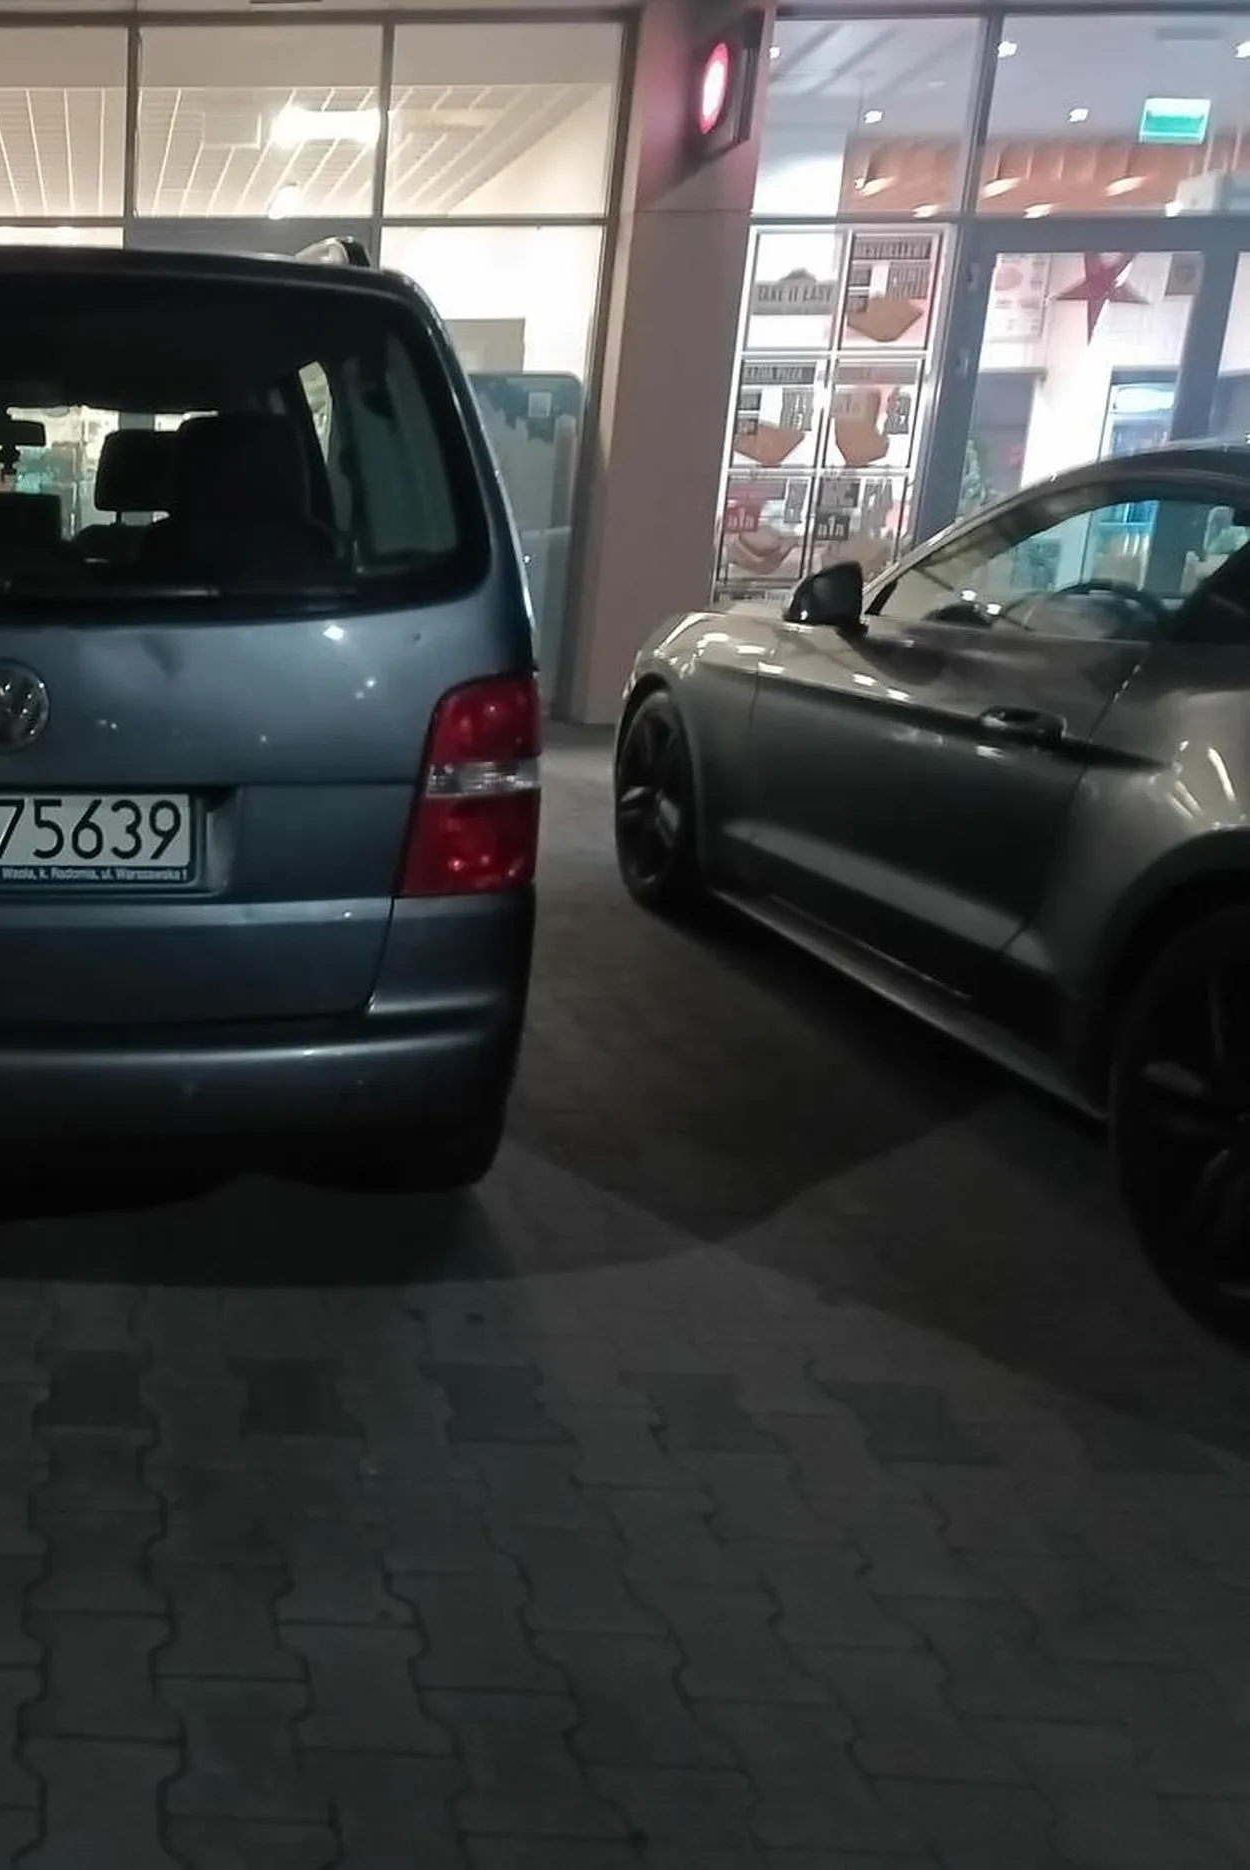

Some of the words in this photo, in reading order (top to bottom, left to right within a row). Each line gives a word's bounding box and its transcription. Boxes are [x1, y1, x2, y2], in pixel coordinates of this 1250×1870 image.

[757, 284, 783, 303] TAKE
[787, 284, 799, 303] IT
[803, 284, 833, 303] EASY
